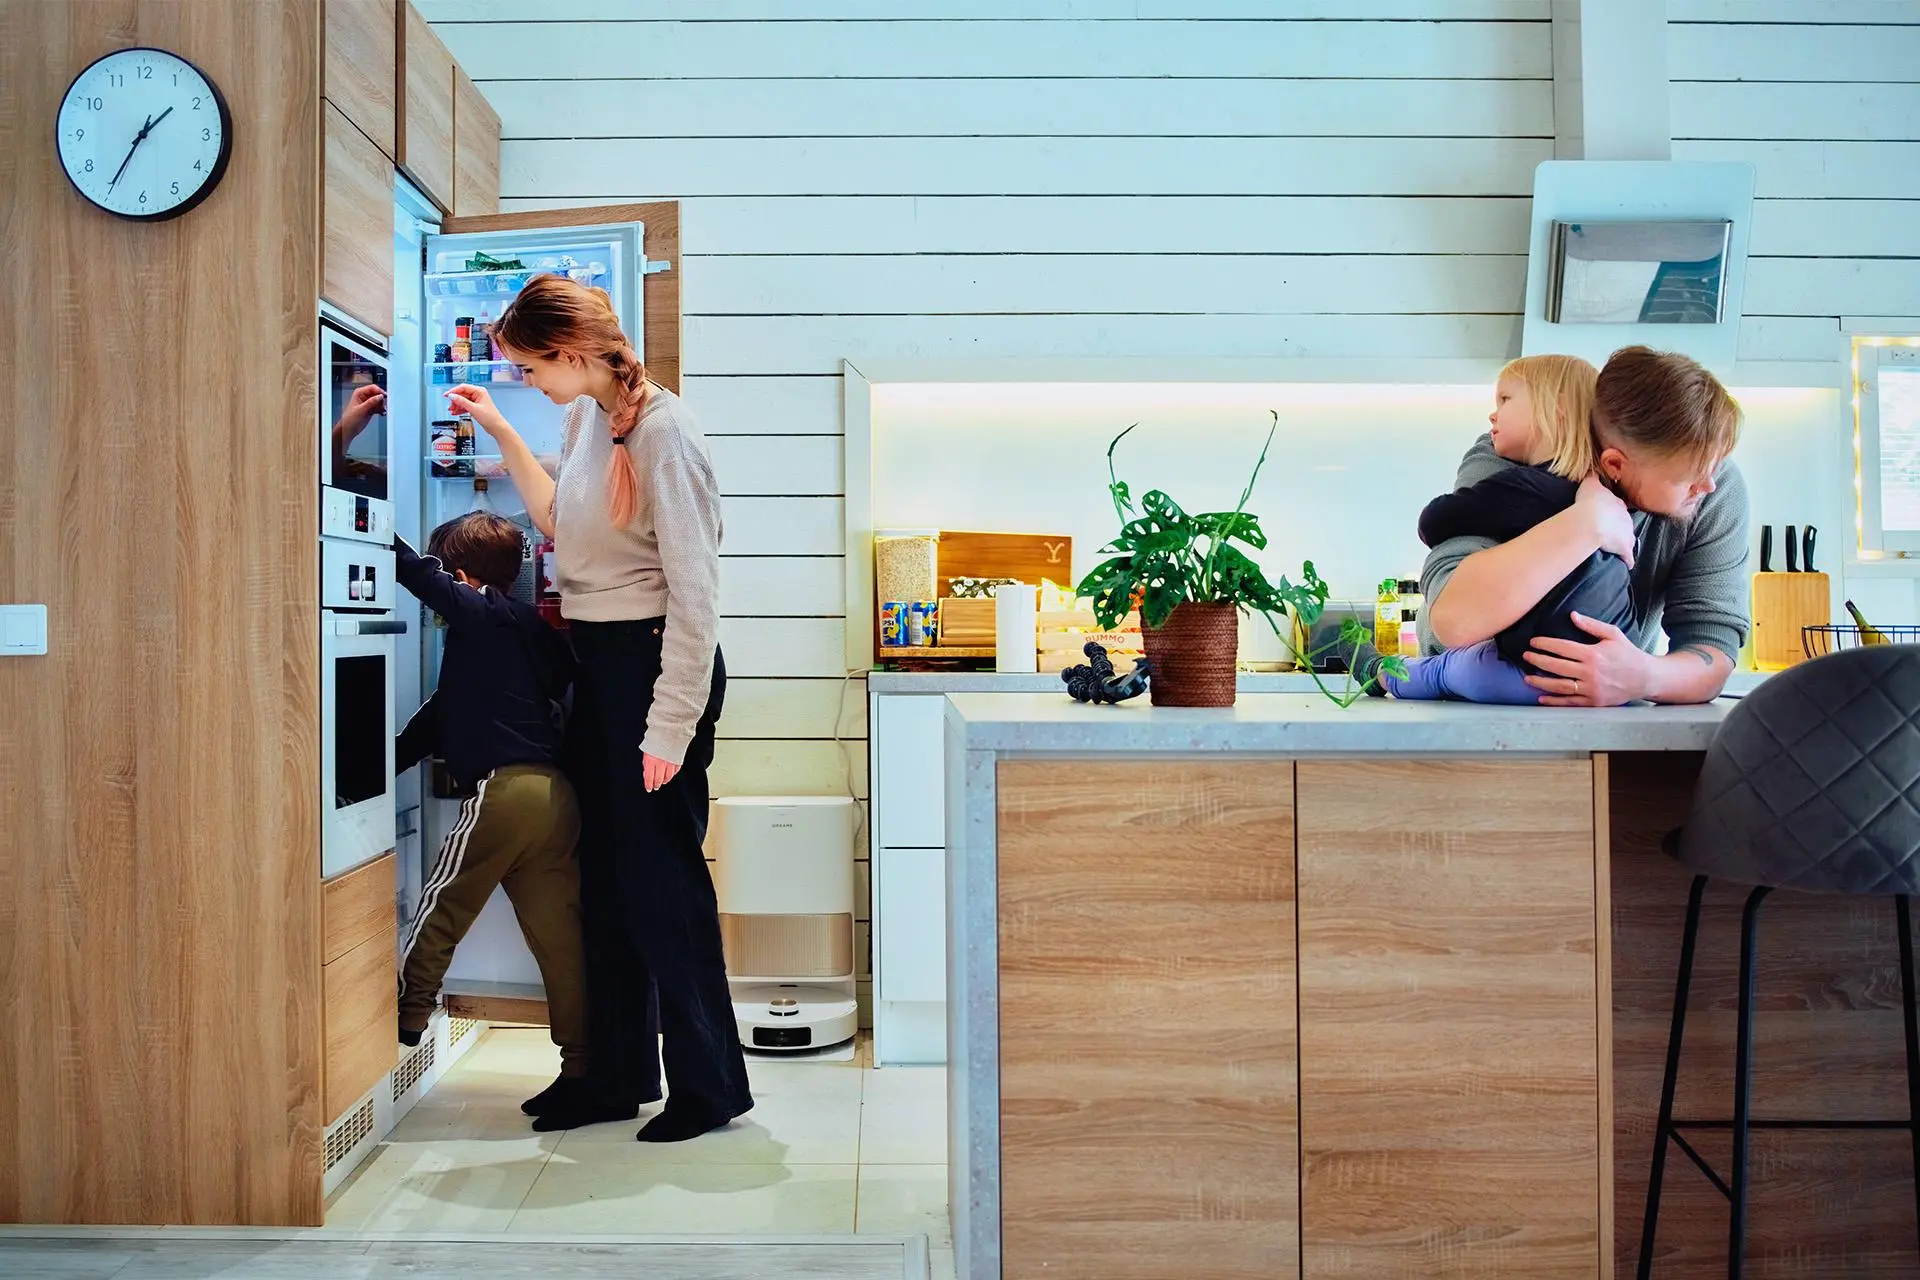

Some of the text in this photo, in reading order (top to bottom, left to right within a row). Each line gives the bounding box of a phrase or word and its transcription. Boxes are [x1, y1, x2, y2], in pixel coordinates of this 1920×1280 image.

[136, 66, 153, 80] 12
[110, 74, 124, 87] 11
[172, 74, 178, 87] 1
[86, 97, 103, 111] 10
[191, 97, 201, 110] 2
[75, 128, 85, 141] 9
[201, 128, 211, 142] 3
[84, 159, 94, 172] 8
[193, 159, 202, 171] 4
[170, 182, 179, 195] 5
[138, 191, 147, 204] 6
